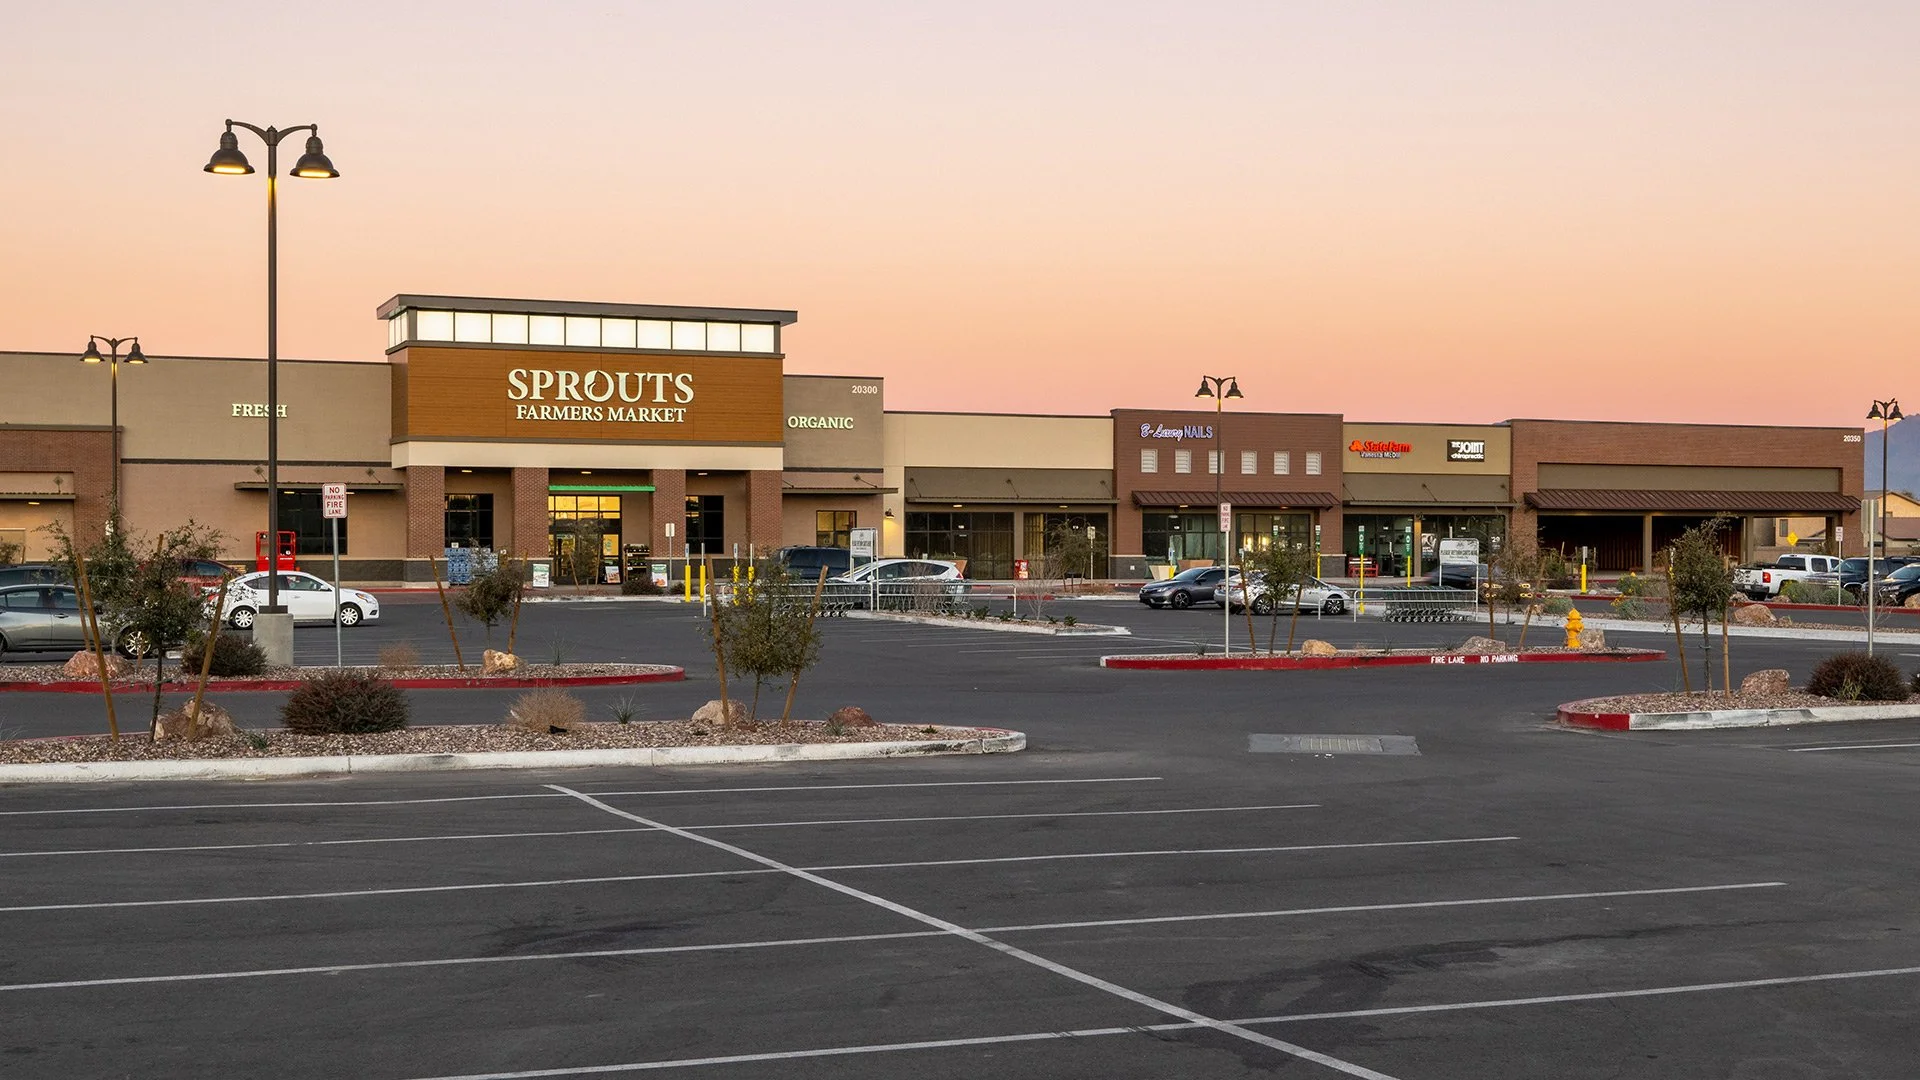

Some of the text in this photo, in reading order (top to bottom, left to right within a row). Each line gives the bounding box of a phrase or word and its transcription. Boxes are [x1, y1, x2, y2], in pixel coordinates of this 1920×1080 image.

[507, 368, 695, 404] SPROUTS
[851, 385, 878, 394] 20300
[516, 404, 687, 423] FARMERS MARKET
[787, 415, 854, 429] ORGANIC
[1184, 425, 1213, 439] NAILS
[1458, 441, 1484, 453] JOINT
[1430, 656, 1466, 664] FIRE LANE
[1480, 654, 1519, 663] NO PARKING
